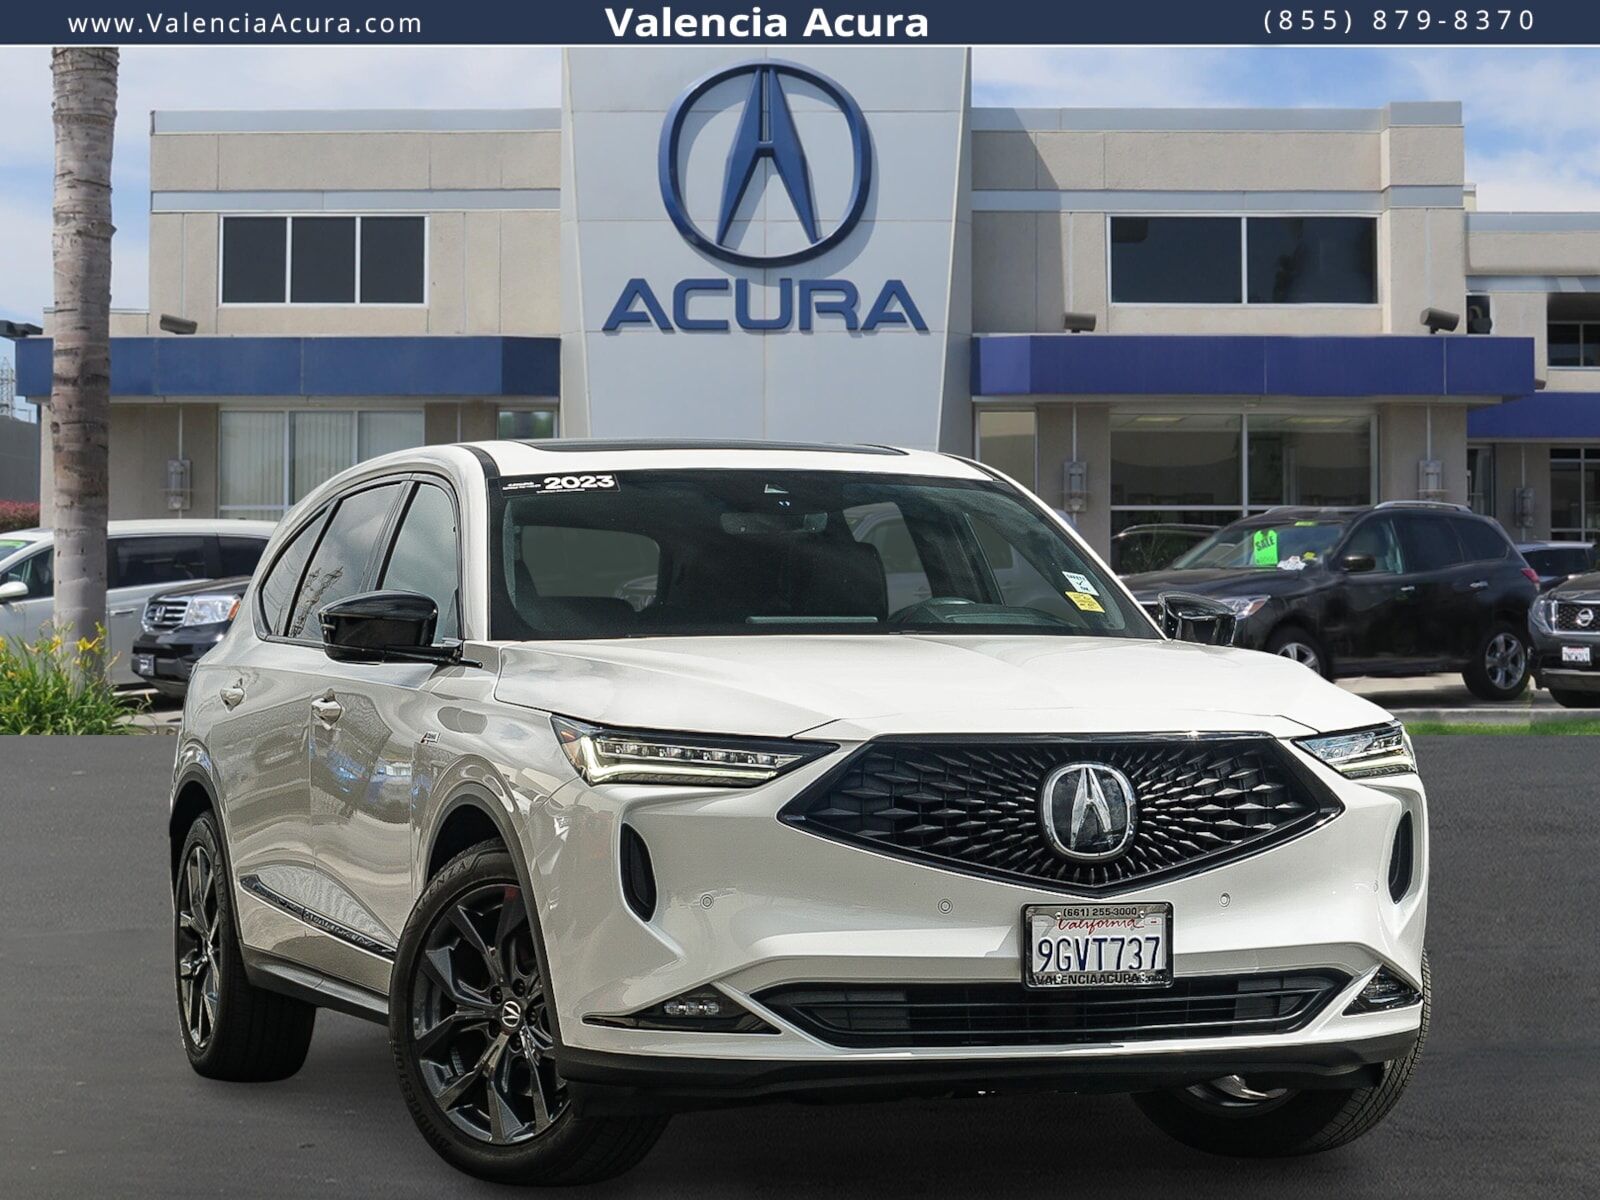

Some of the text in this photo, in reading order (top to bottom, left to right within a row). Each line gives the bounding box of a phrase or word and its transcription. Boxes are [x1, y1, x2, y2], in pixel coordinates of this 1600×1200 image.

[602, 278, 929, 331] ACURA
[544, 475, 616, 490] 2023
[1255, 535, 1275, 552] SALE
[1063, 907, 1137, 917] (661) 255-3000
[1057, 918, 1144, 935] California
[1038, 936, 1160, 972] 9GVT737
